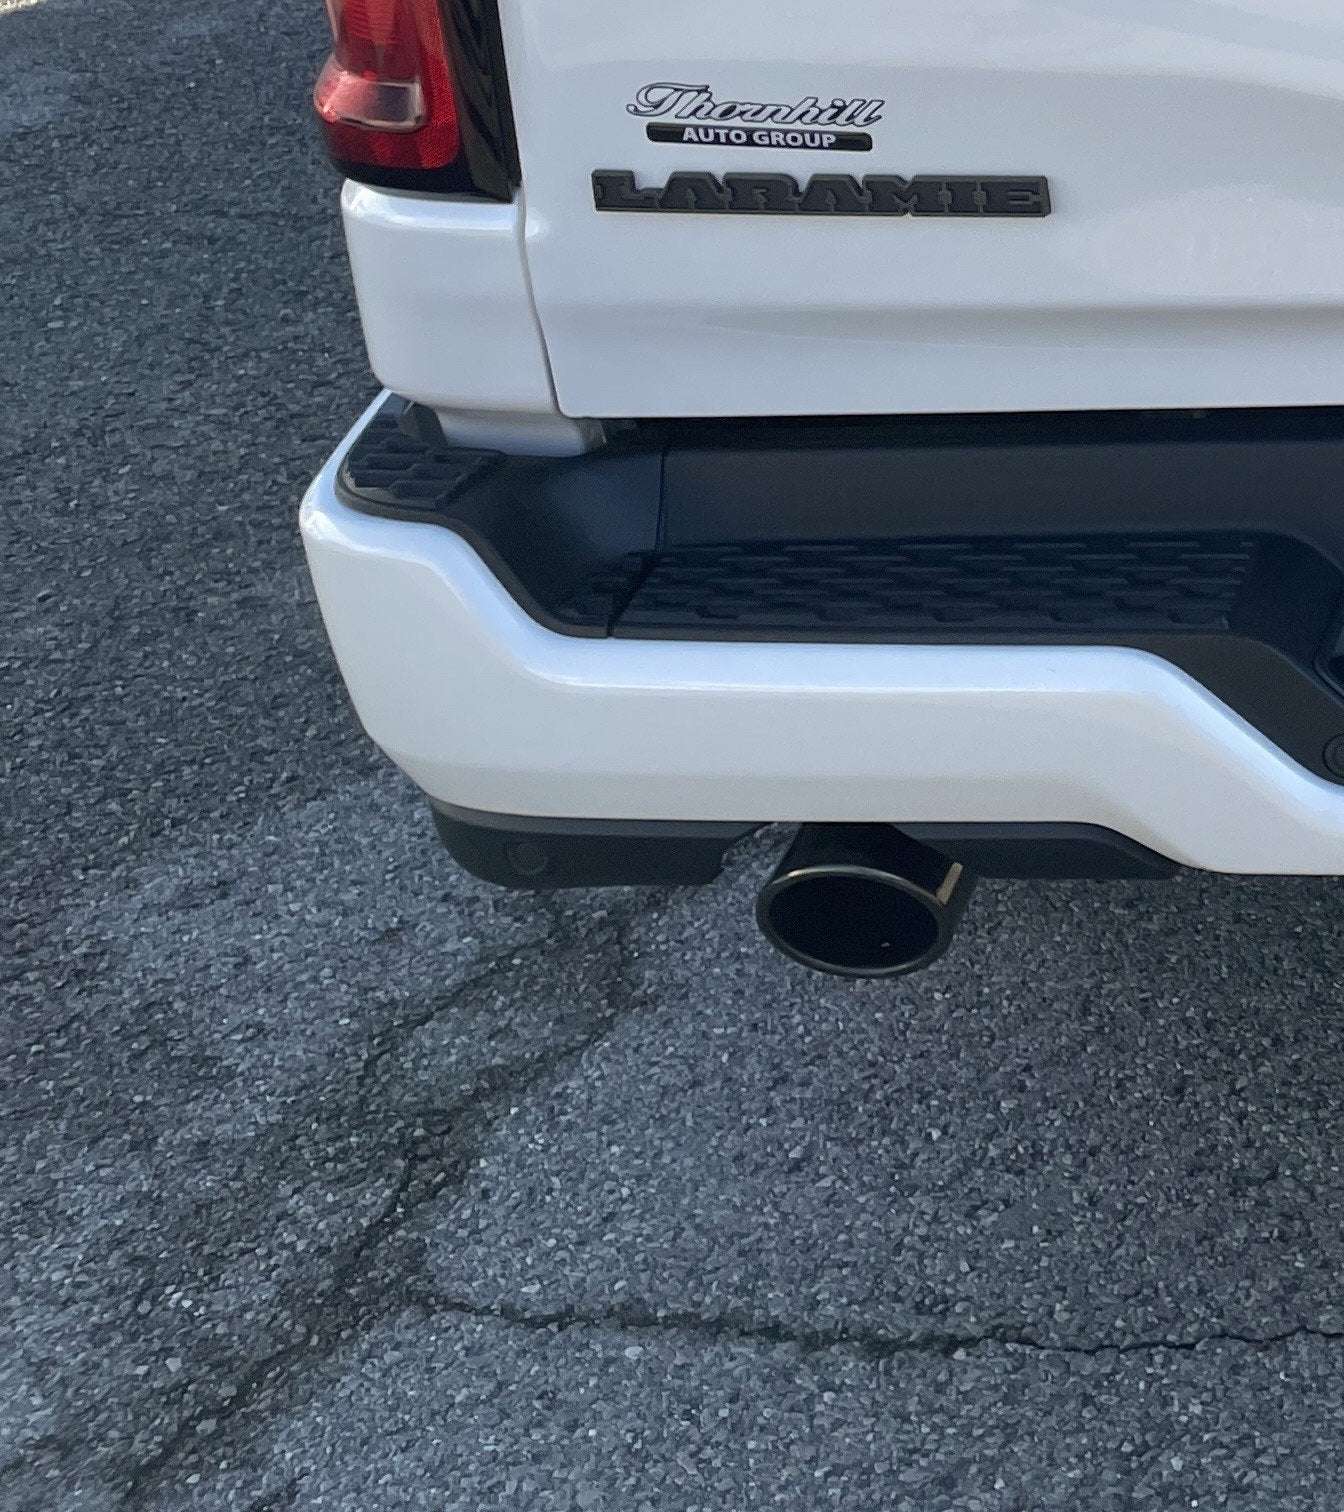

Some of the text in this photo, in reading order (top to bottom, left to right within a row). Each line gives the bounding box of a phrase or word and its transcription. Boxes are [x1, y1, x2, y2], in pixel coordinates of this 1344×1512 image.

[626, 82, 886, 129] Thornhill
[682, 127, 837, 149] AUTO GROUP
[591, 169, 1052, 218] LARAMIE
